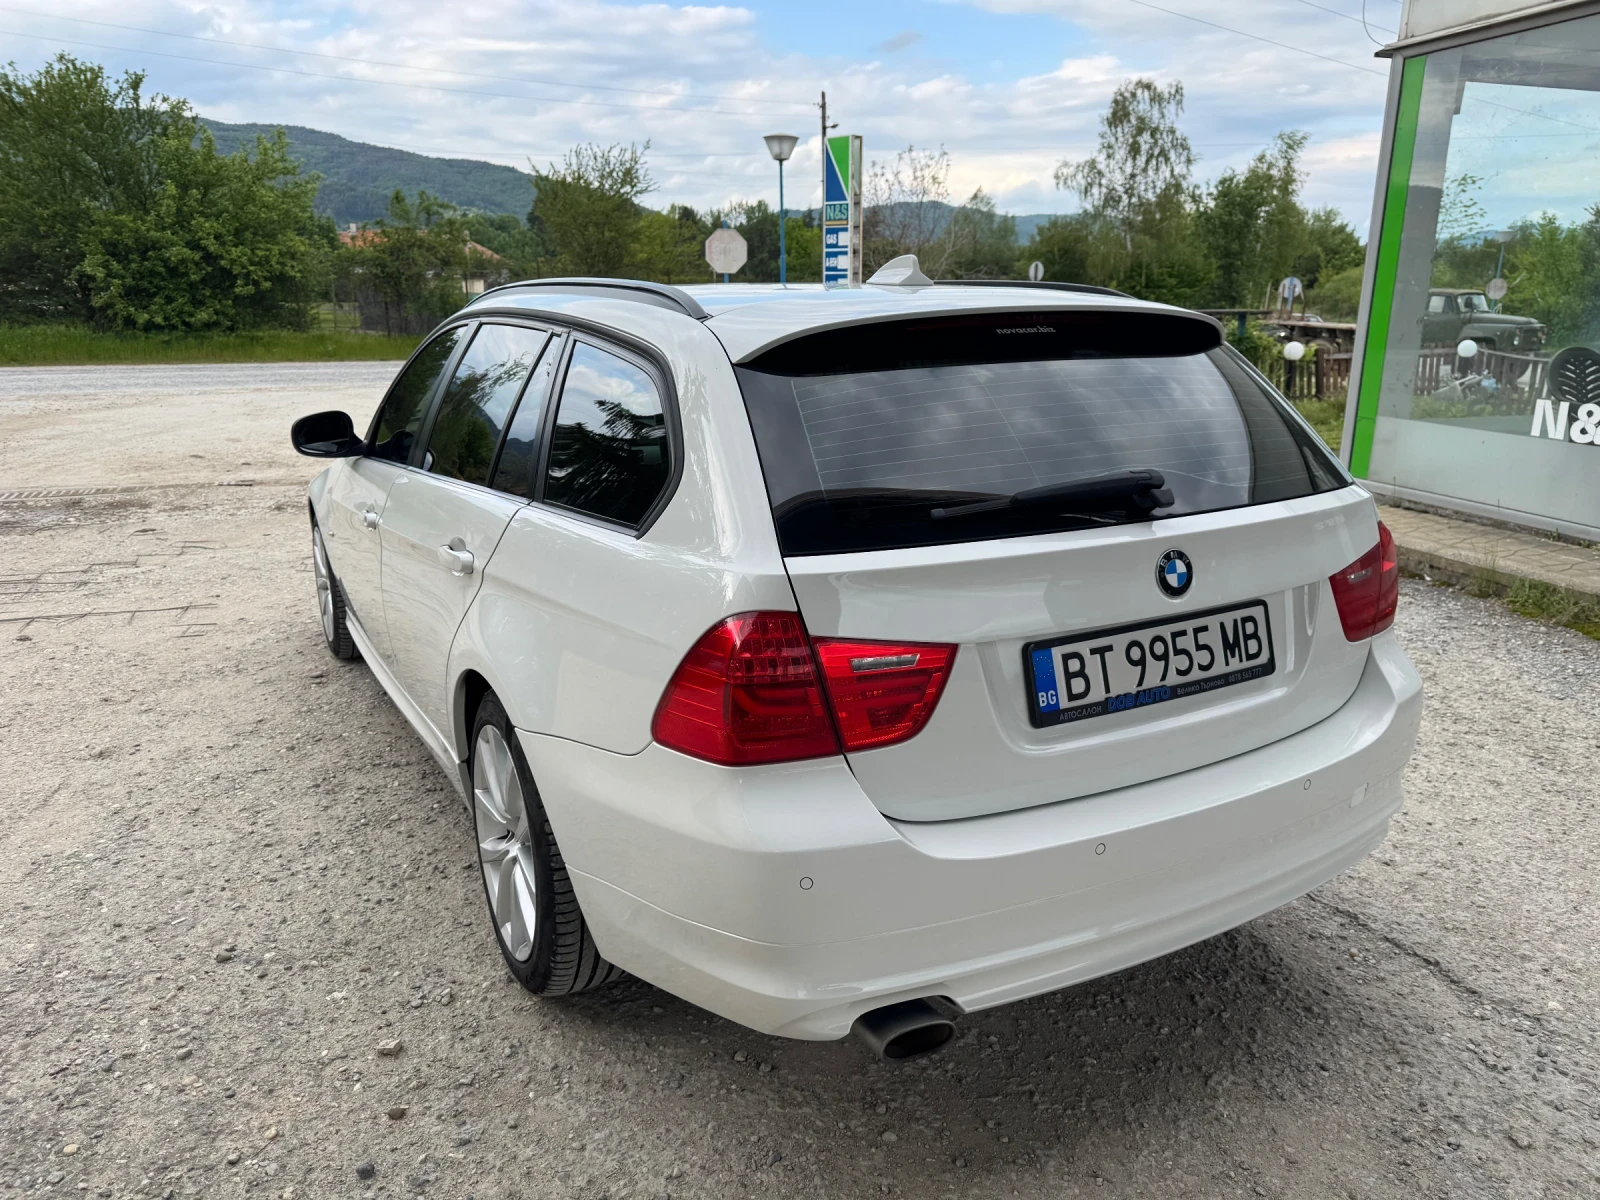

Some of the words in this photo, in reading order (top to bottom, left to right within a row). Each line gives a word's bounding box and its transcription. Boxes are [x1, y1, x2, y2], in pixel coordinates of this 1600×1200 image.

[826, 204, 848, 220] N&S
[826, 233, 837, 244] GAS
[996, 325, 1056, 334] novacar.biz
[1160, 551, 1189, 567] BMW
[1061, 644, 1114, 702] BT
[1125, 625, 1215, 688] 9955
[1219, 615, 1263, 667] MB
[1038, 690, 1057, 707] BG
[1059, 705, 1102, 720] АВТОСАЛОН
[1136, 686, 1171, 706] AUTO
[1177, 685, 1199, 695] Велико
[1200, 678, 1225, 690] Търново
[1252, 668, 1262, 677] 777
